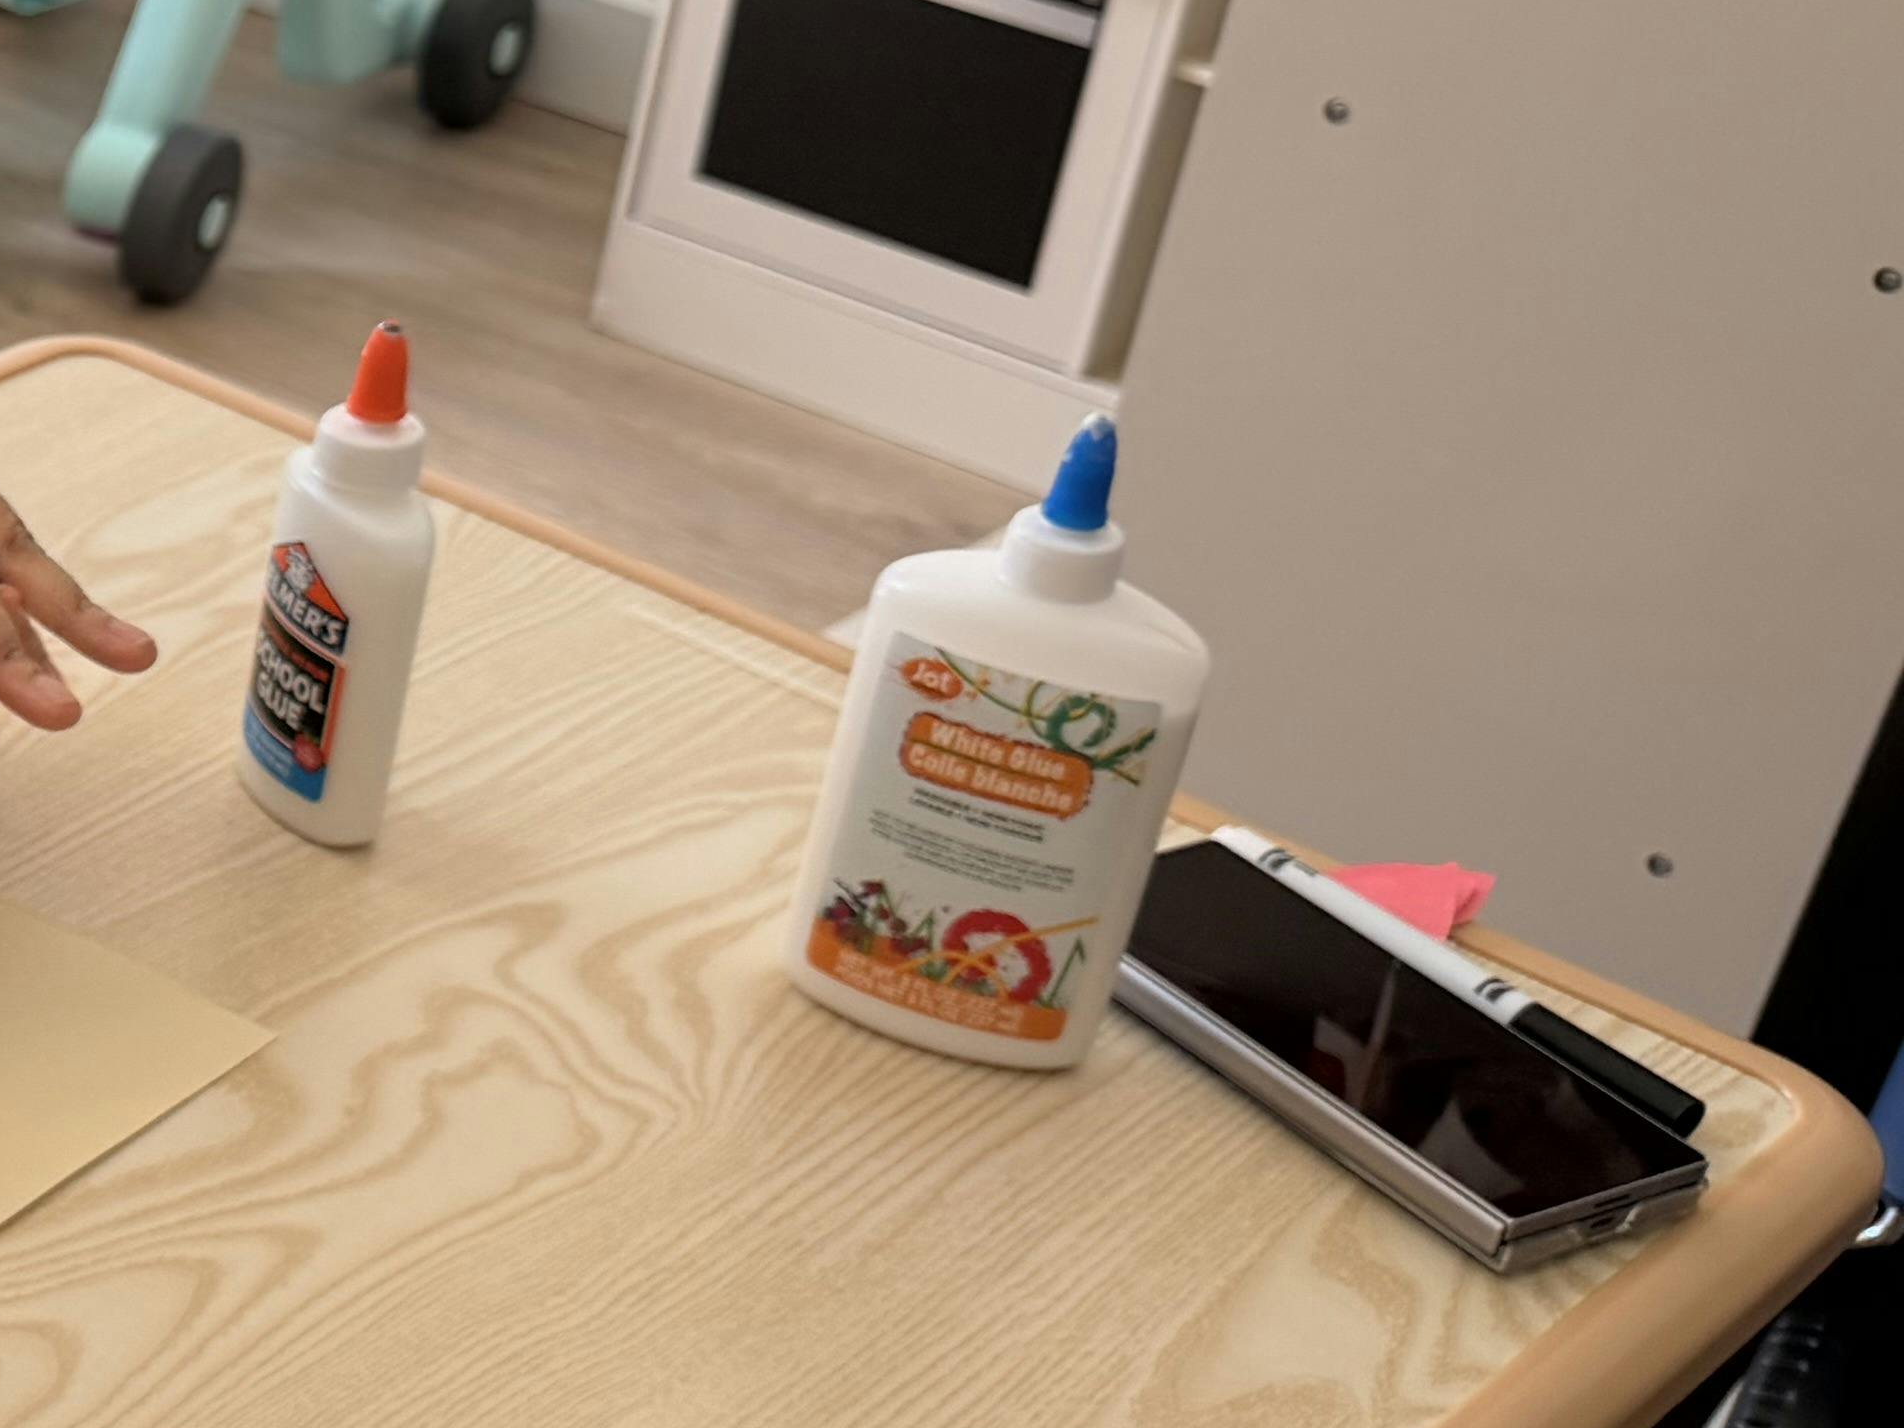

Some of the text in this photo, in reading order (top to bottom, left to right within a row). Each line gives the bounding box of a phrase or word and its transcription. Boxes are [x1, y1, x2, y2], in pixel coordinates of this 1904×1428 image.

[256, 672, 305, 732] GLUE
[908, 743, 968, 781] Colle
[930, 721, 1066, 780] White Glue
